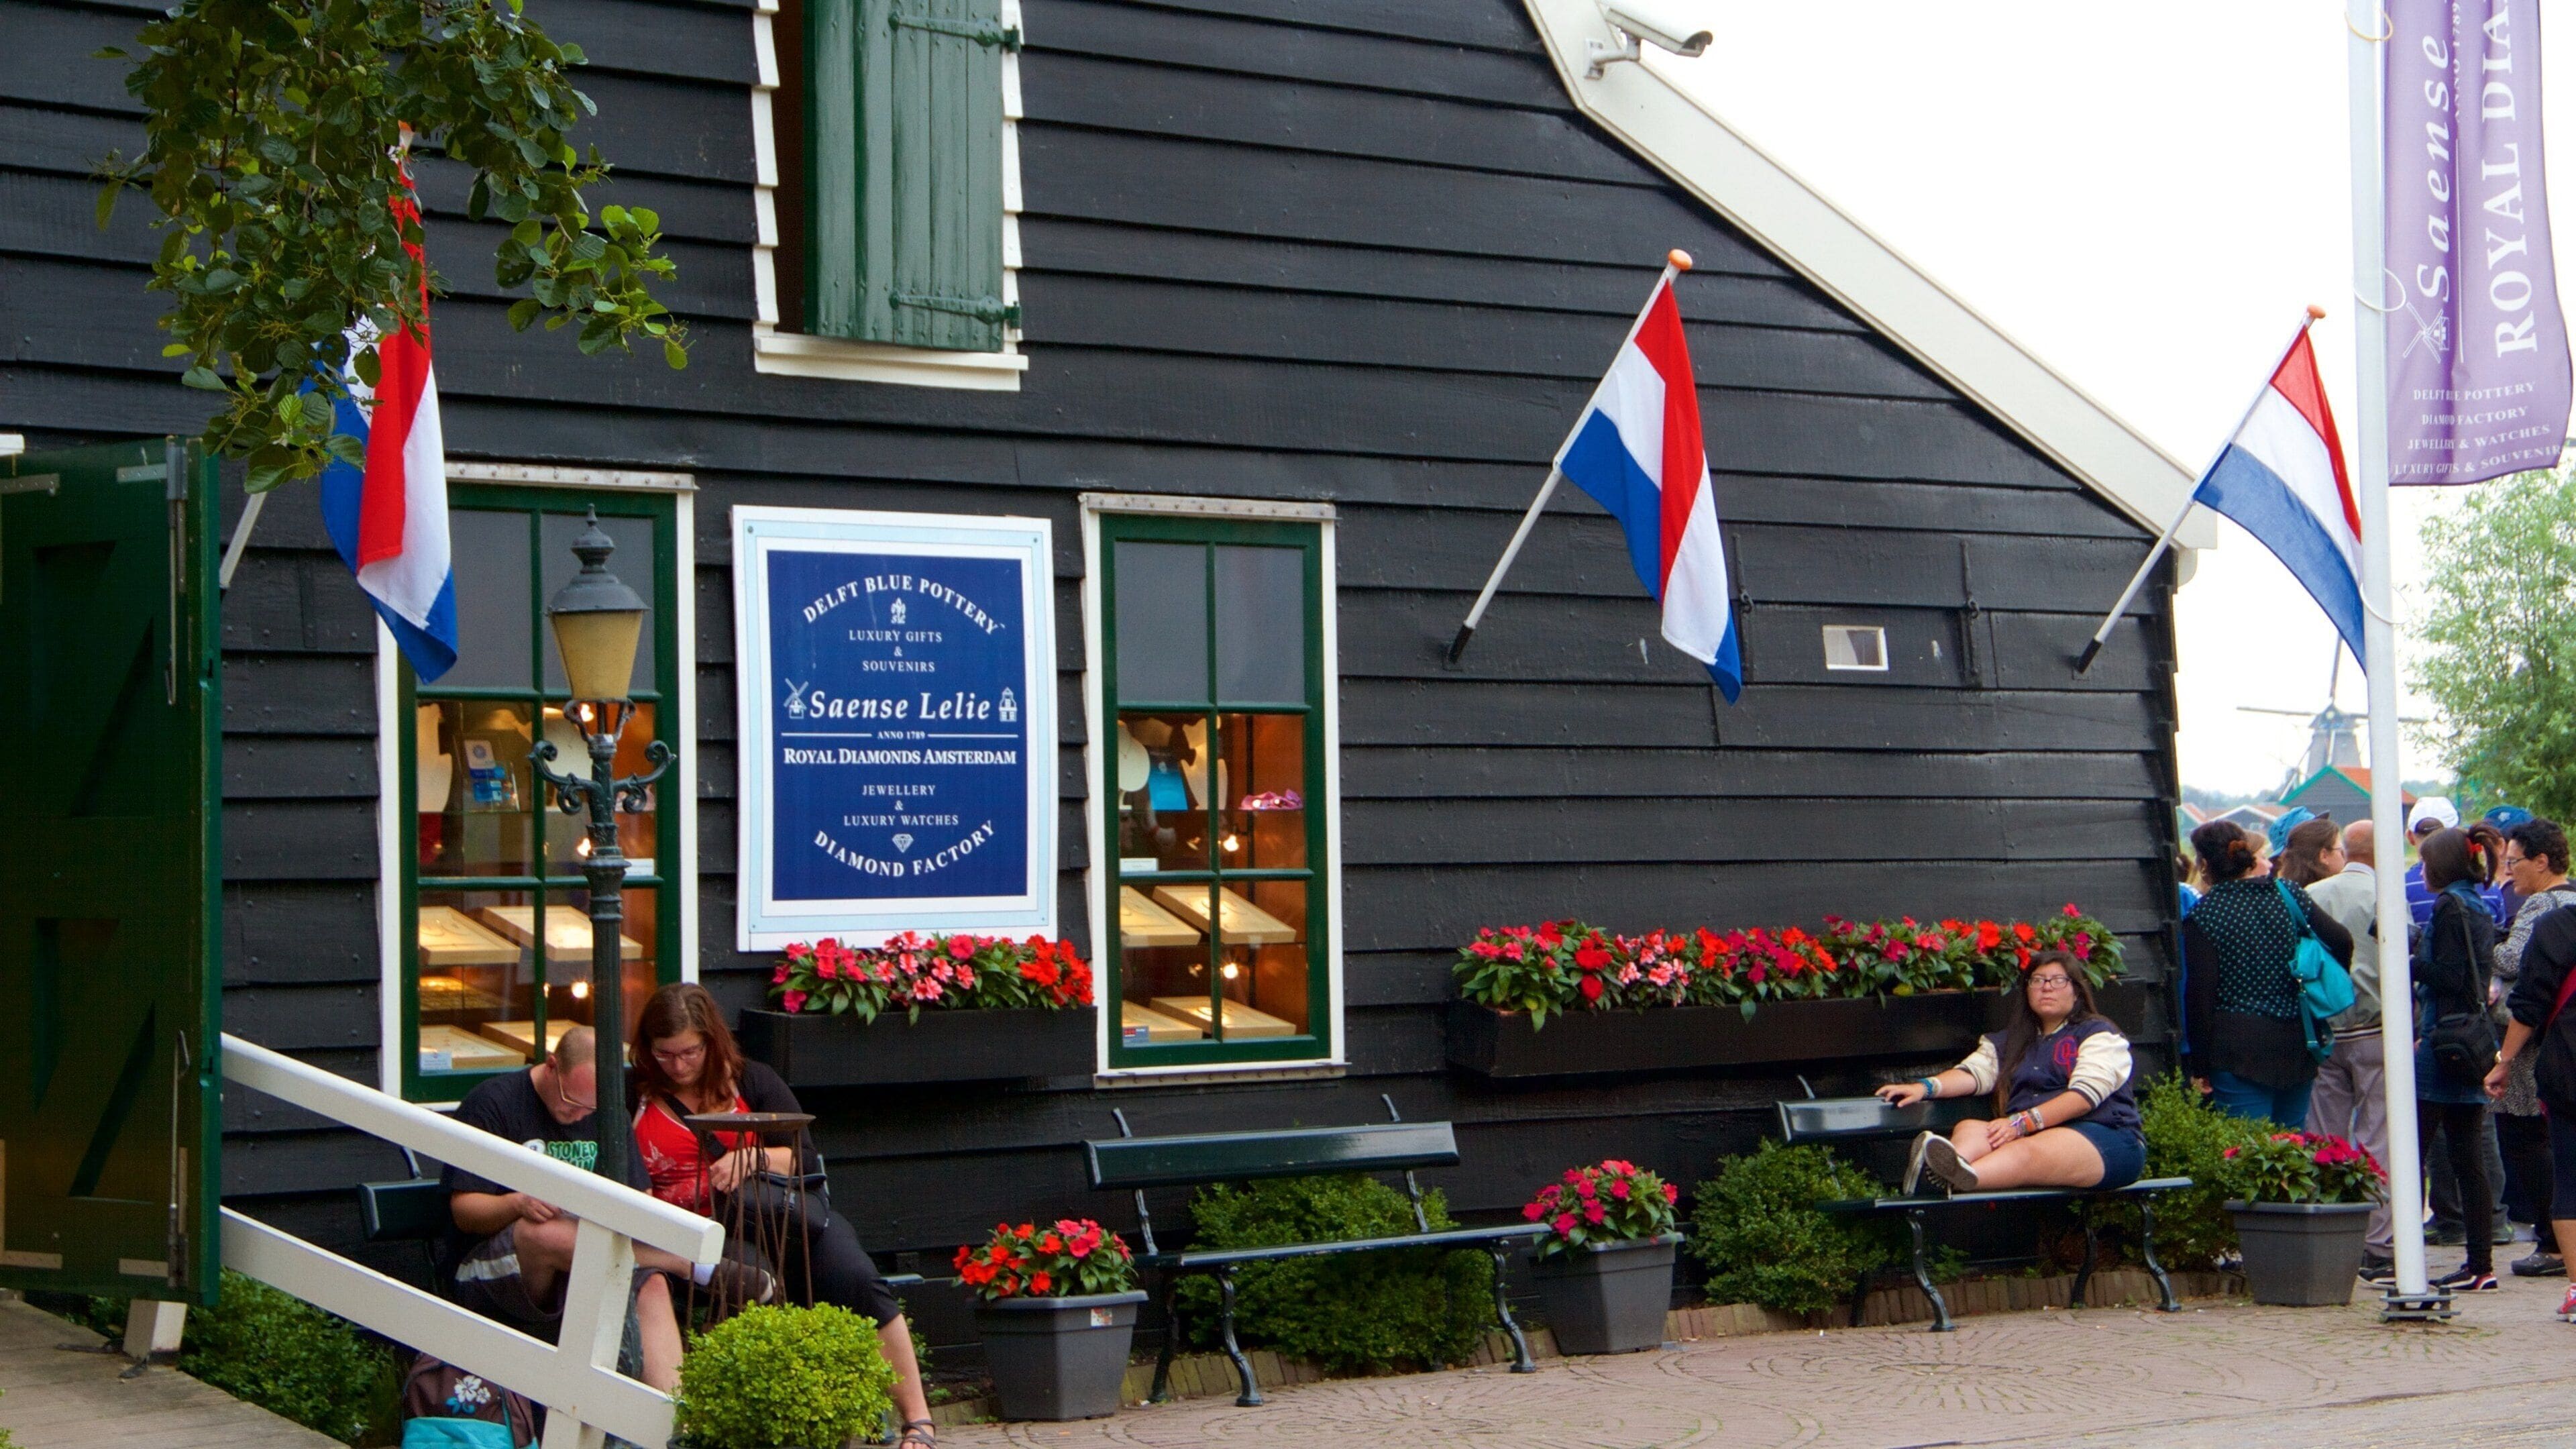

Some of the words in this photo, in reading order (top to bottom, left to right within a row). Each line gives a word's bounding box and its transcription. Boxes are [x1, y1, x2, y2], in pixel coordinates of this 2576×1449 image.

[2482, 0, 2516, 123] DIA
[2416, 35, 2449, 303] Saense
[2483, 142, 2538, 358] ROYAL
[2465, 381, 2536, 400] POTTERY
[2457, 406, 2528, 425] FACTORY
[2459, 439, 2469, 449] &
[2474, 424, 2550, 447] WATCHES
[2395, 463, 2434, 475] LUXURY
[2464, 461, 2476, 472] &
[803, 581, 858, 623] DELFT
[864, 575, 912, 592] BLUE
[919, 578, 991, 635] POTTERY
[849, 630, 900, 641] LUXURY
[906, 631, 942, 642] GIFTS
[894, 646, 903, 657] &
[863, 661, 935, 672] SOUVENIRS
[810, 690, 908, 719] Saense
[919, 692, 990, 720] Lelie
[877, 731, 904, 739] ANNO
[906, 731, 925, 739] 1789
[784, 748, 837, 764] ROYAL
[839, 748, 921, 764] DIAMONDS
[923, 749, 1016, 764] AMSTERDAM
[862, 785, 936, 796] JEWELLERY
[894, 800, 904, 810] &
[844, 815, 895, 826] LUXURY
[901, 814, 959, 825] WATCHES
[814, 830, 904, 877] DIAMOND
[912, 819, 995, 875] FACTORY
[547, 1140, 598, 1159] STONED
